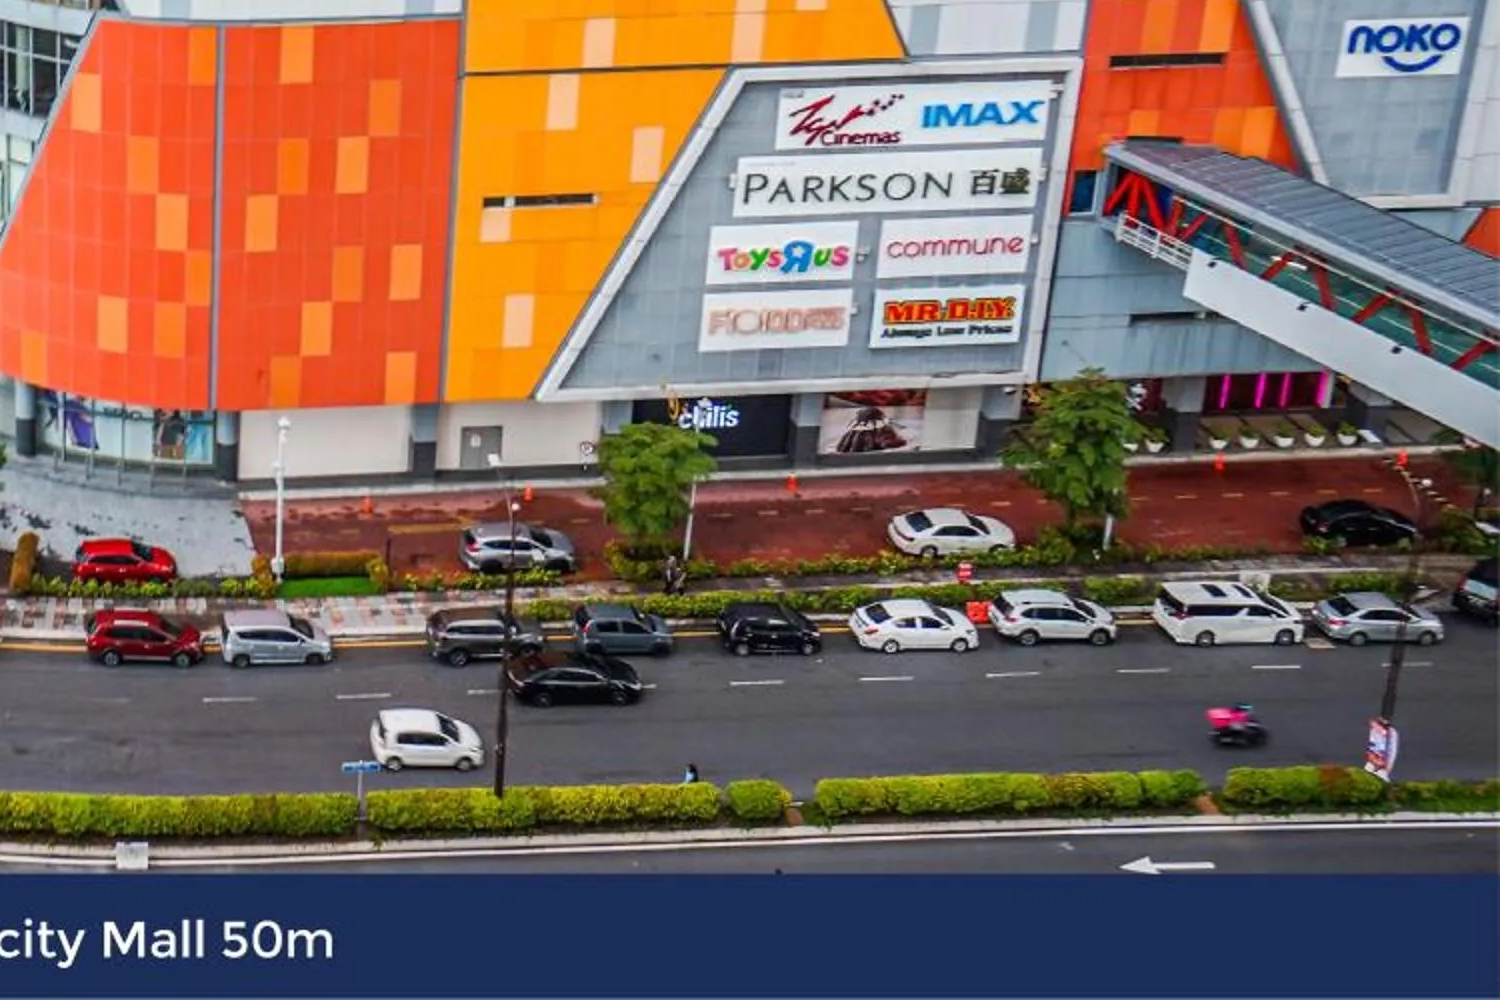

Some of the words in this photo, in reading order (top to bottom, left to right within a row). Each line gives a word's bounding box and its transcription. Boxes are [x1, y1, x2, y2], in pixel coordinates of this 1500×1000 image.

[921, 101, 1045, 129] IMAX
[820, 130, 901, 147] Cinemas
[743, 172, 953, 204] PARKSON
[887, 236, 1024, 259] commune
